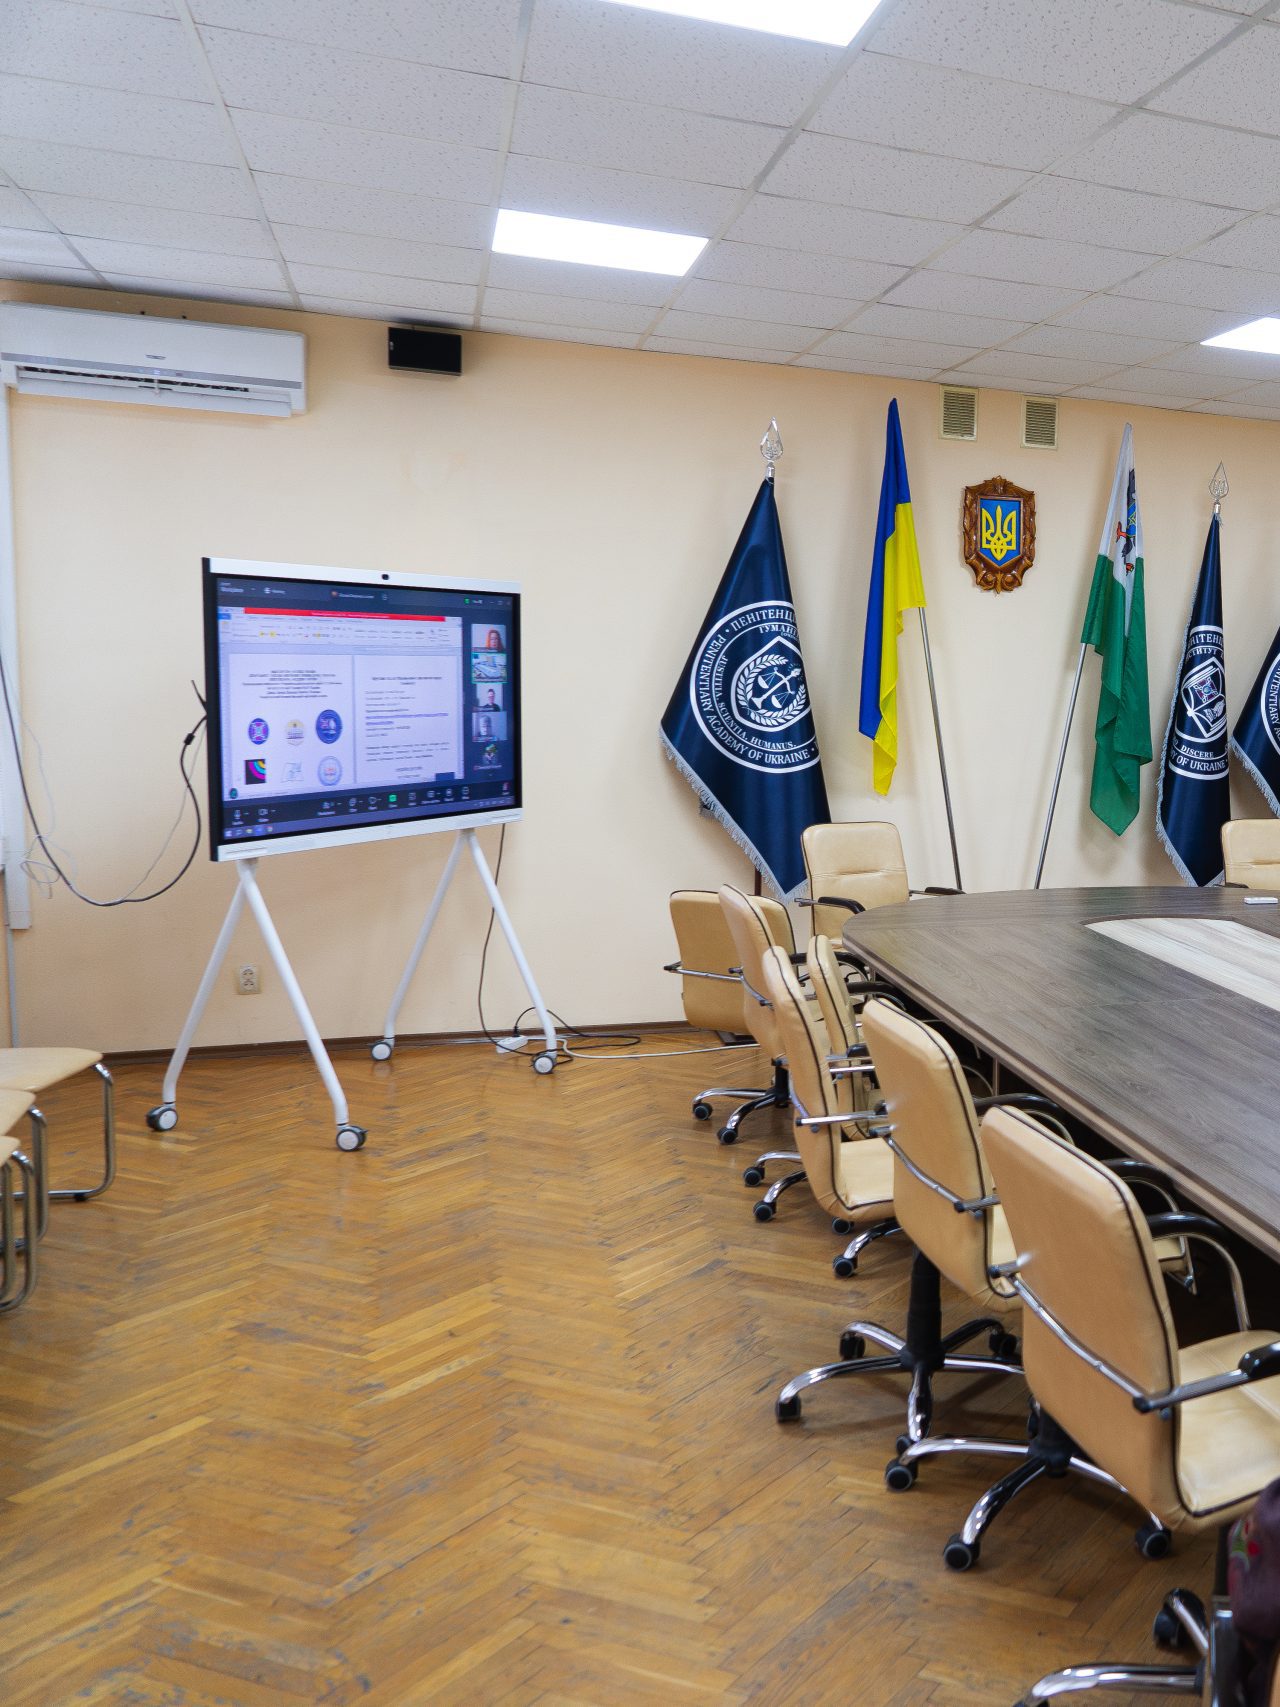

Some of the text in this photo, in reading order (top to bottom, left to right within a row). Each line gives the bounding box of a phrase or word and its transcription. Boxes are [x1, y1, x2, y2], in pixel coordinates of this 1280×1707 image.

[699, 634, 810, 765] PENITENTIARY ACADEMY OF UKRAINE
[1181, 744, 1214, 758] DISCERE
[1176, 755, 1189, 766] OF
[1190, 759, 1226, 771] UKRAINE
